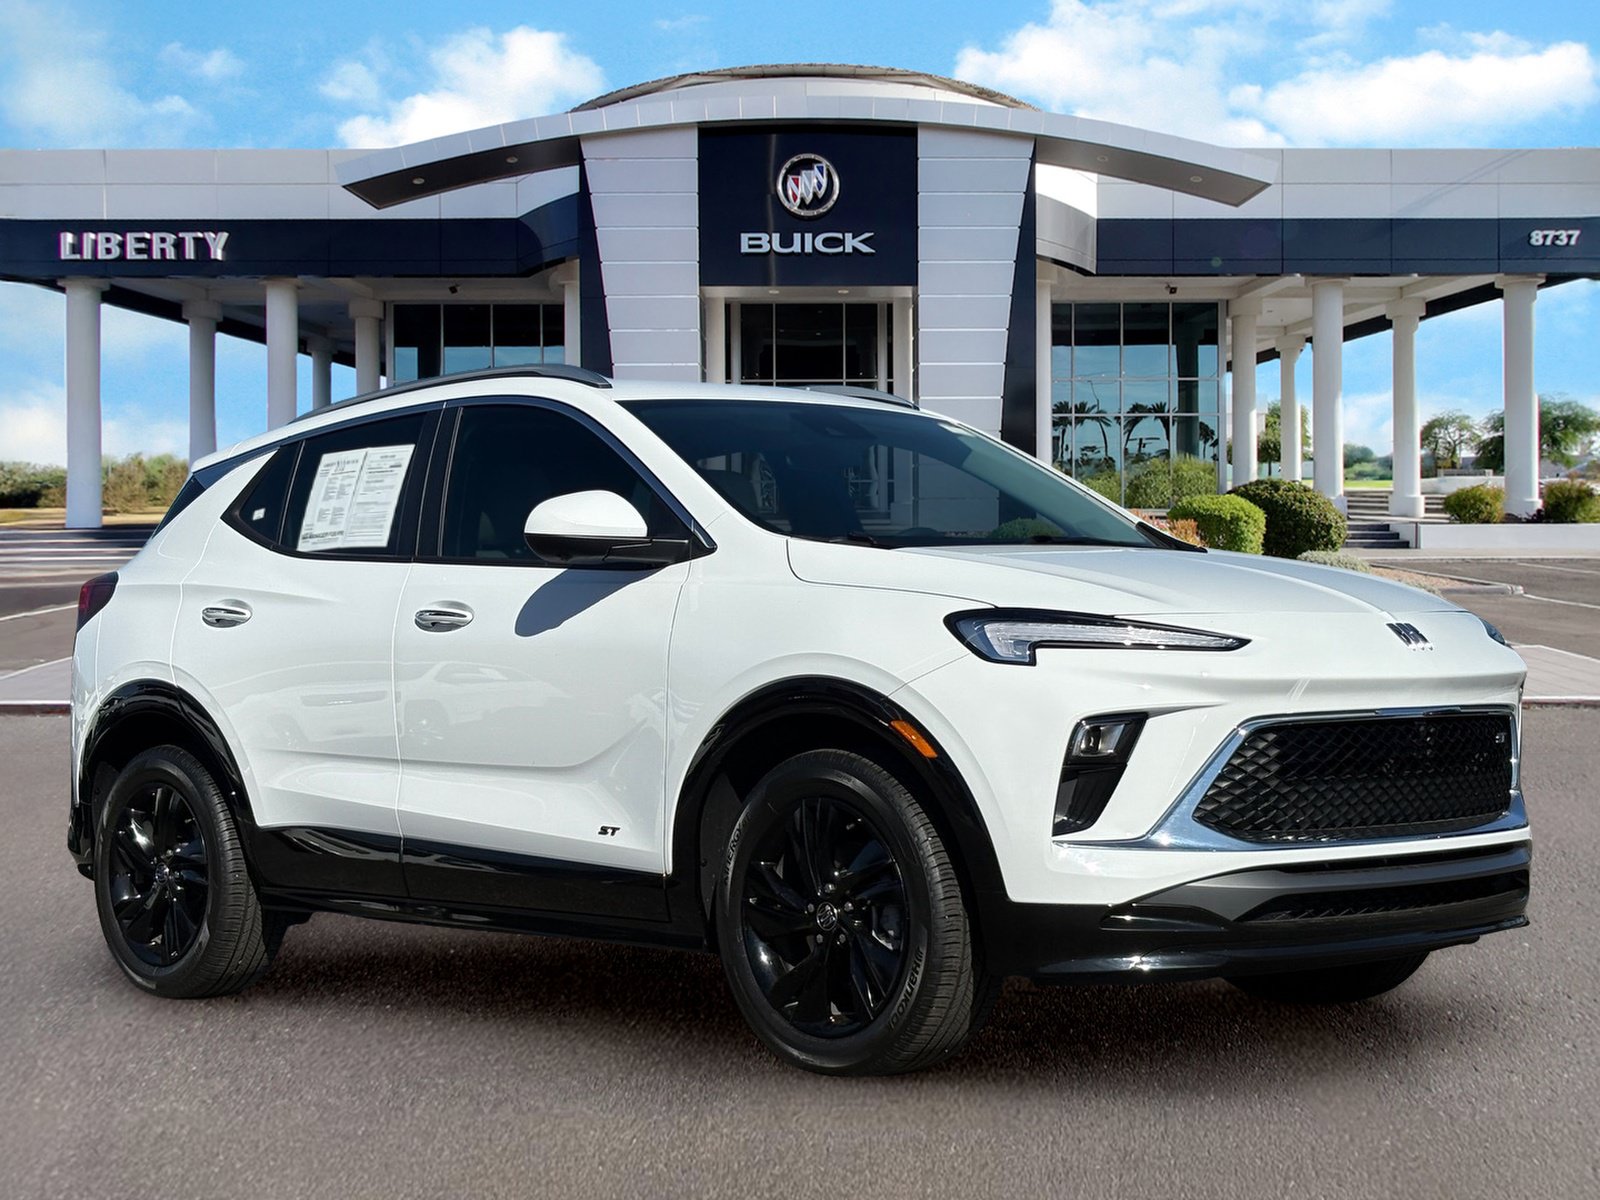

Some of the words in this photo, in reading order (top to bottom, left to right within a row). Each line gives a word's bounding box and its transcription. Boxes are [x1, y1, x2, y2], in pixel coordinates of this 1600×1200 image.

[59, 231, 230, 261] LIBERTY
[740, 232, 876, 253] BUICK
[1529, 229, 1581, 246] 8737
[598, 825, 621, 836] ST
